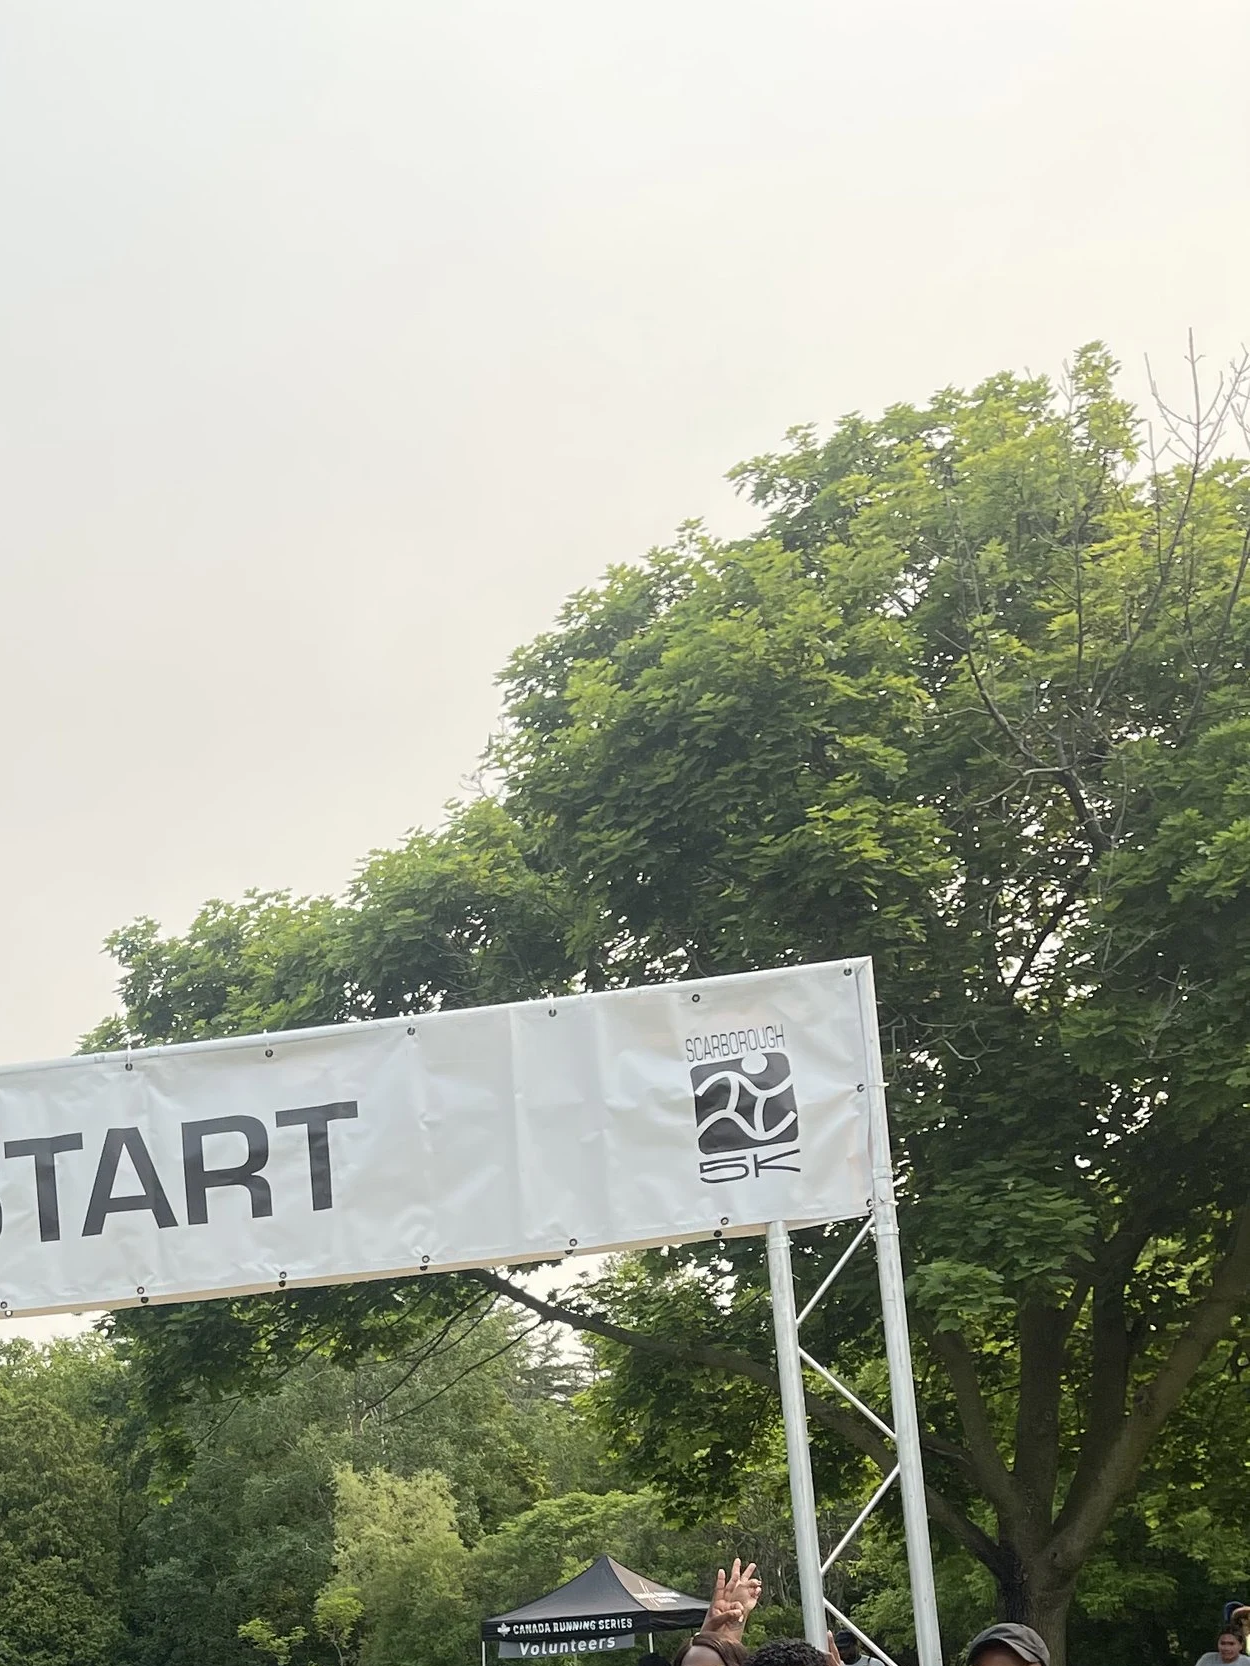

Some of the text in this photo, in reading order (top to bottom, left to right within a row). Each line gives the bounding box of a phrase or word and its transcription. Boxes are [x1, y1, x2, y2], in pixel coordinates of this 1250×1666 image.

[685, 1023, 786, 1062] SCARBOROUGH
[699, 1148, 801, 1184] 5K
[512, 1617, 633, 1635] CANADA RUNNING SERIES
[519, 1635, 616, 1656] Volunteers
